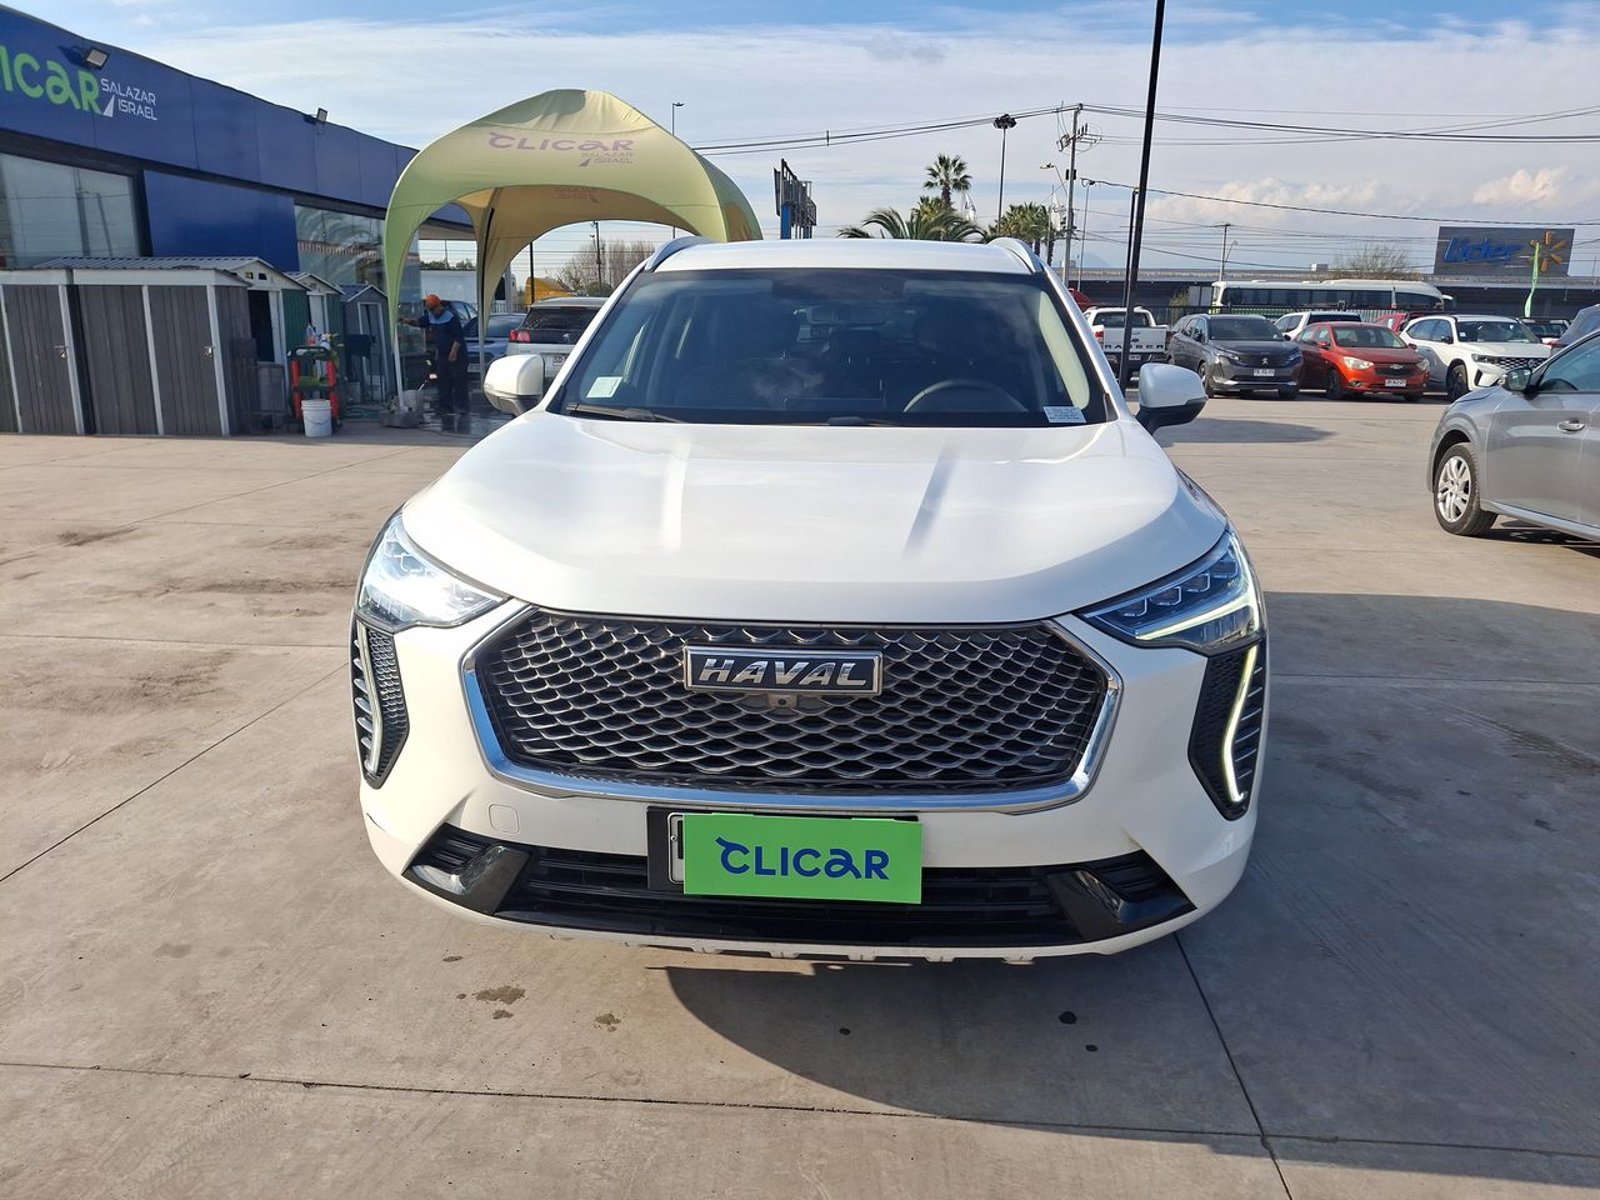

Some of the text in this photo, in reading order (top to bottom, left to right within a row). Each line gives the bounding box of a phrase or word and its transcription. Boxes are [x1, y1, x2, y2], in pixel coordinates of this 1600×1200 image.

[101, 78, 157, 105] SALAZAR
[118, 99, 158, 121] ISRAEL
[698, 658, 867, 687] HAVAL
